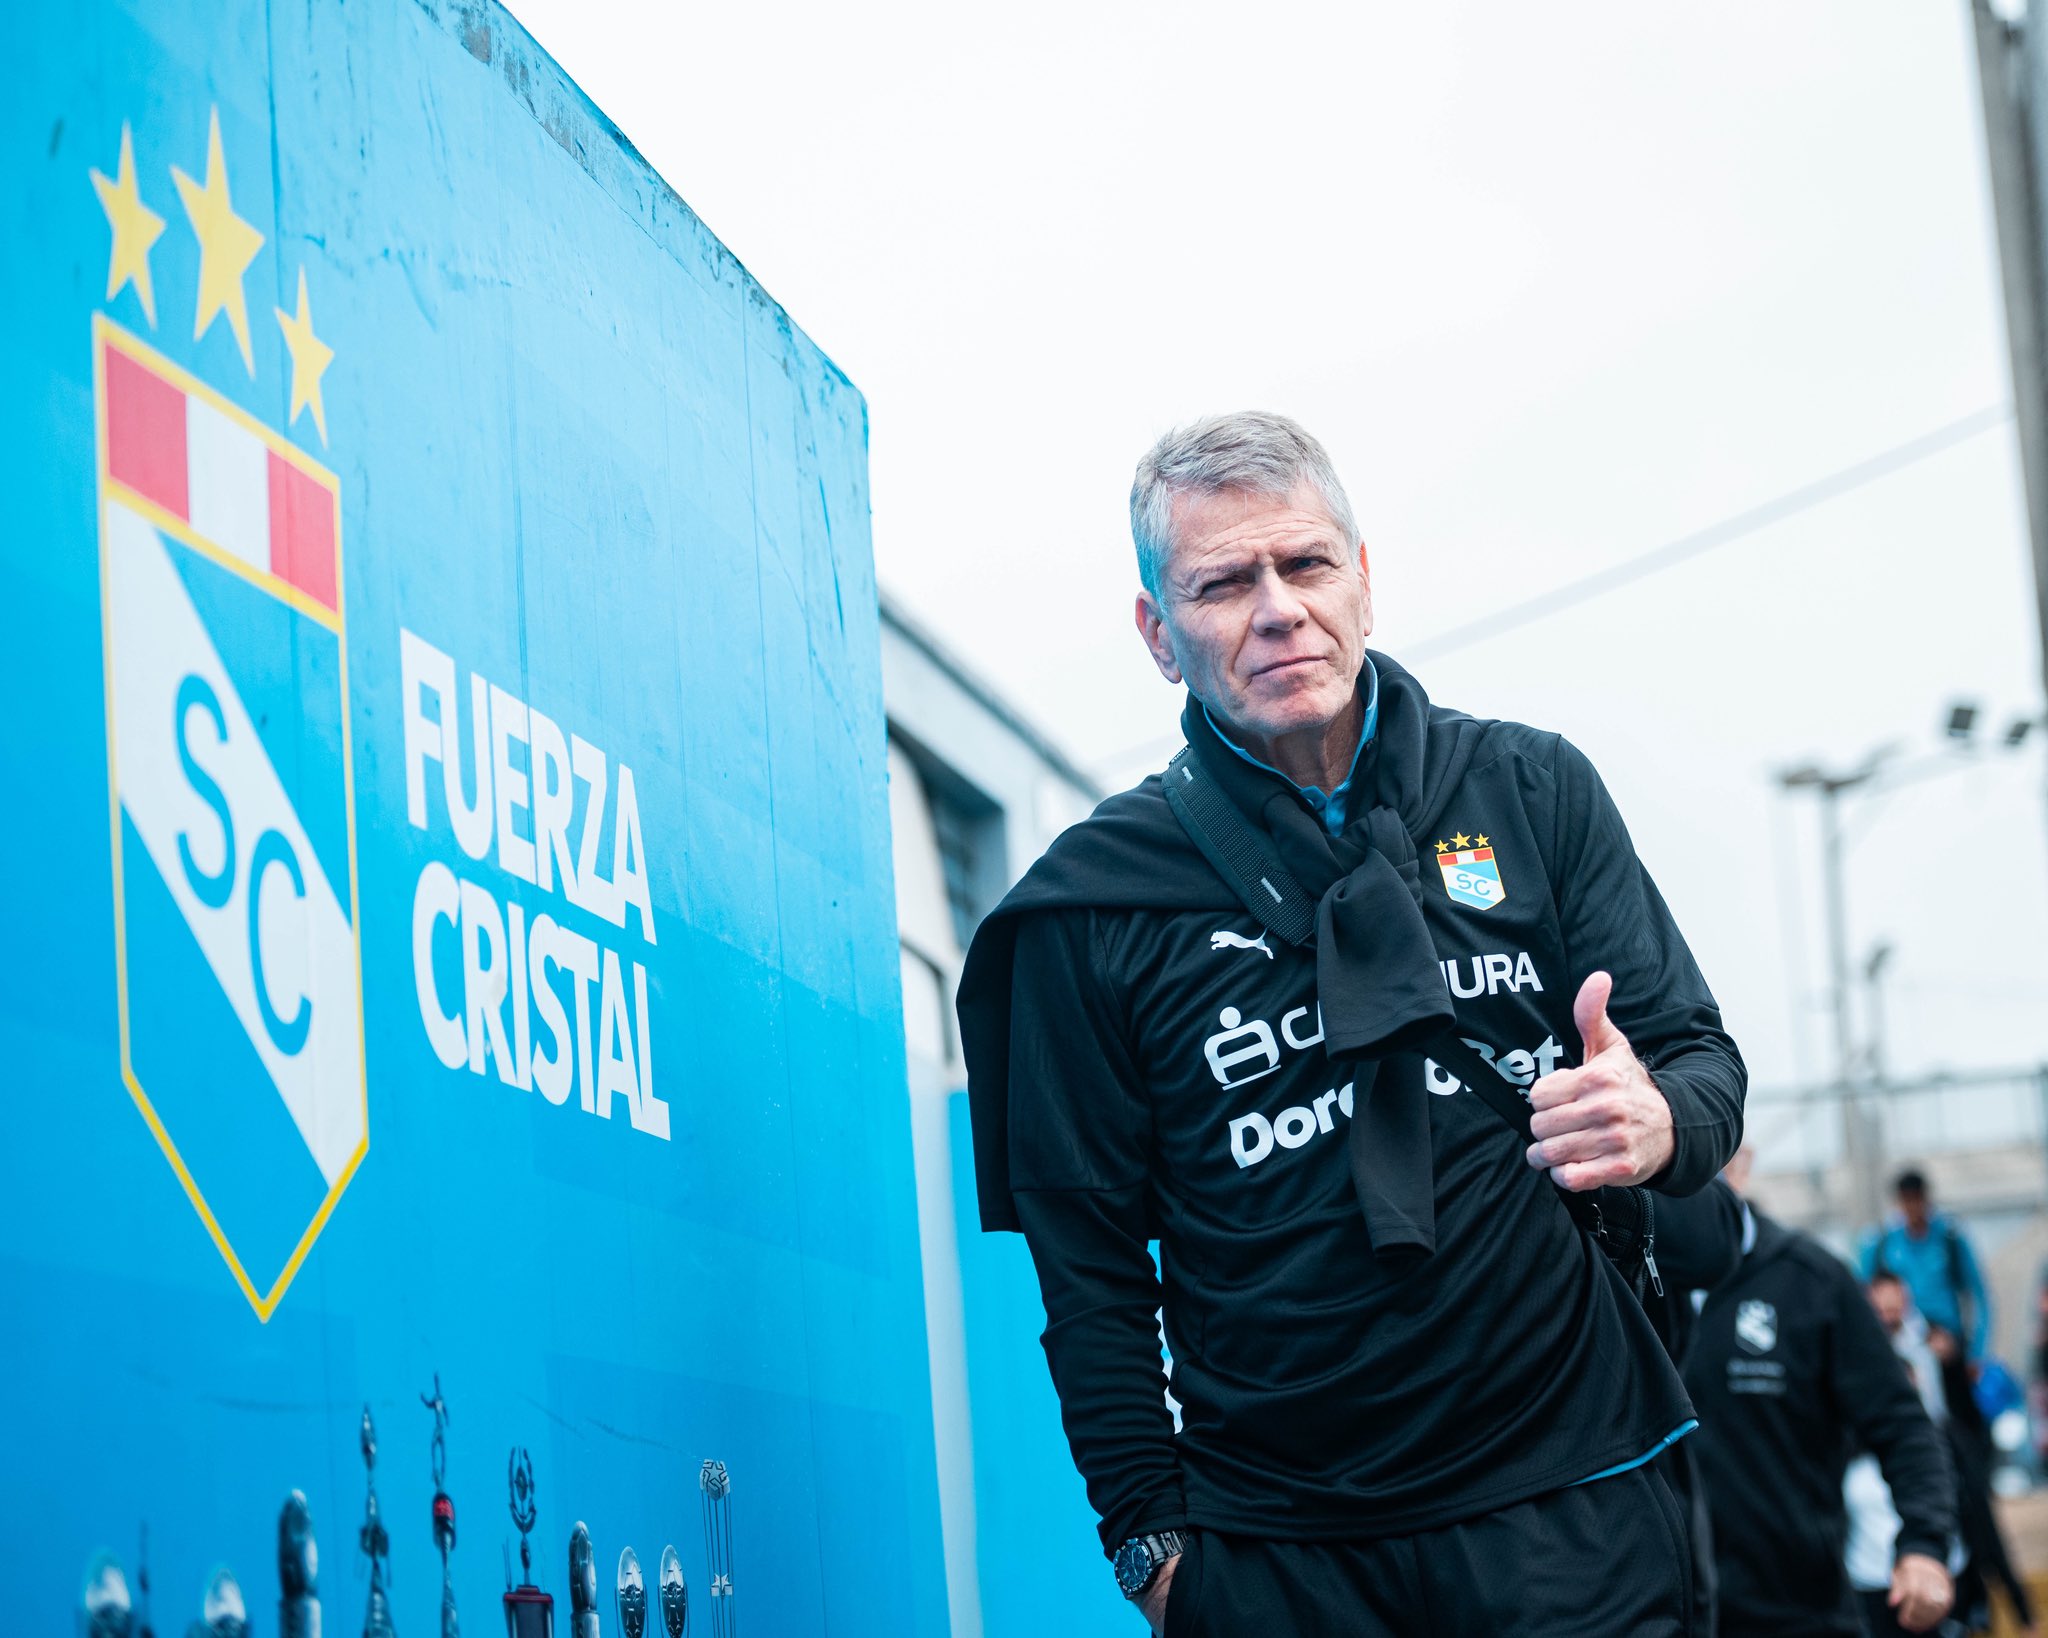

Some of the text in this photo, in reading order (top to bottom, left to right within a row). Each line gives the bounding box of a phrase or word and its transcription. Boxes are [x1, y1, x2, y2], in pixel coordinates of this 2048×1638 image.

[173, 672, 312, 1057] SC
[400, 627, 657, 947] FUERZA
[1456, 873, 1491, 896] SC
[413, 861, 671, 1141] CRISTAL
